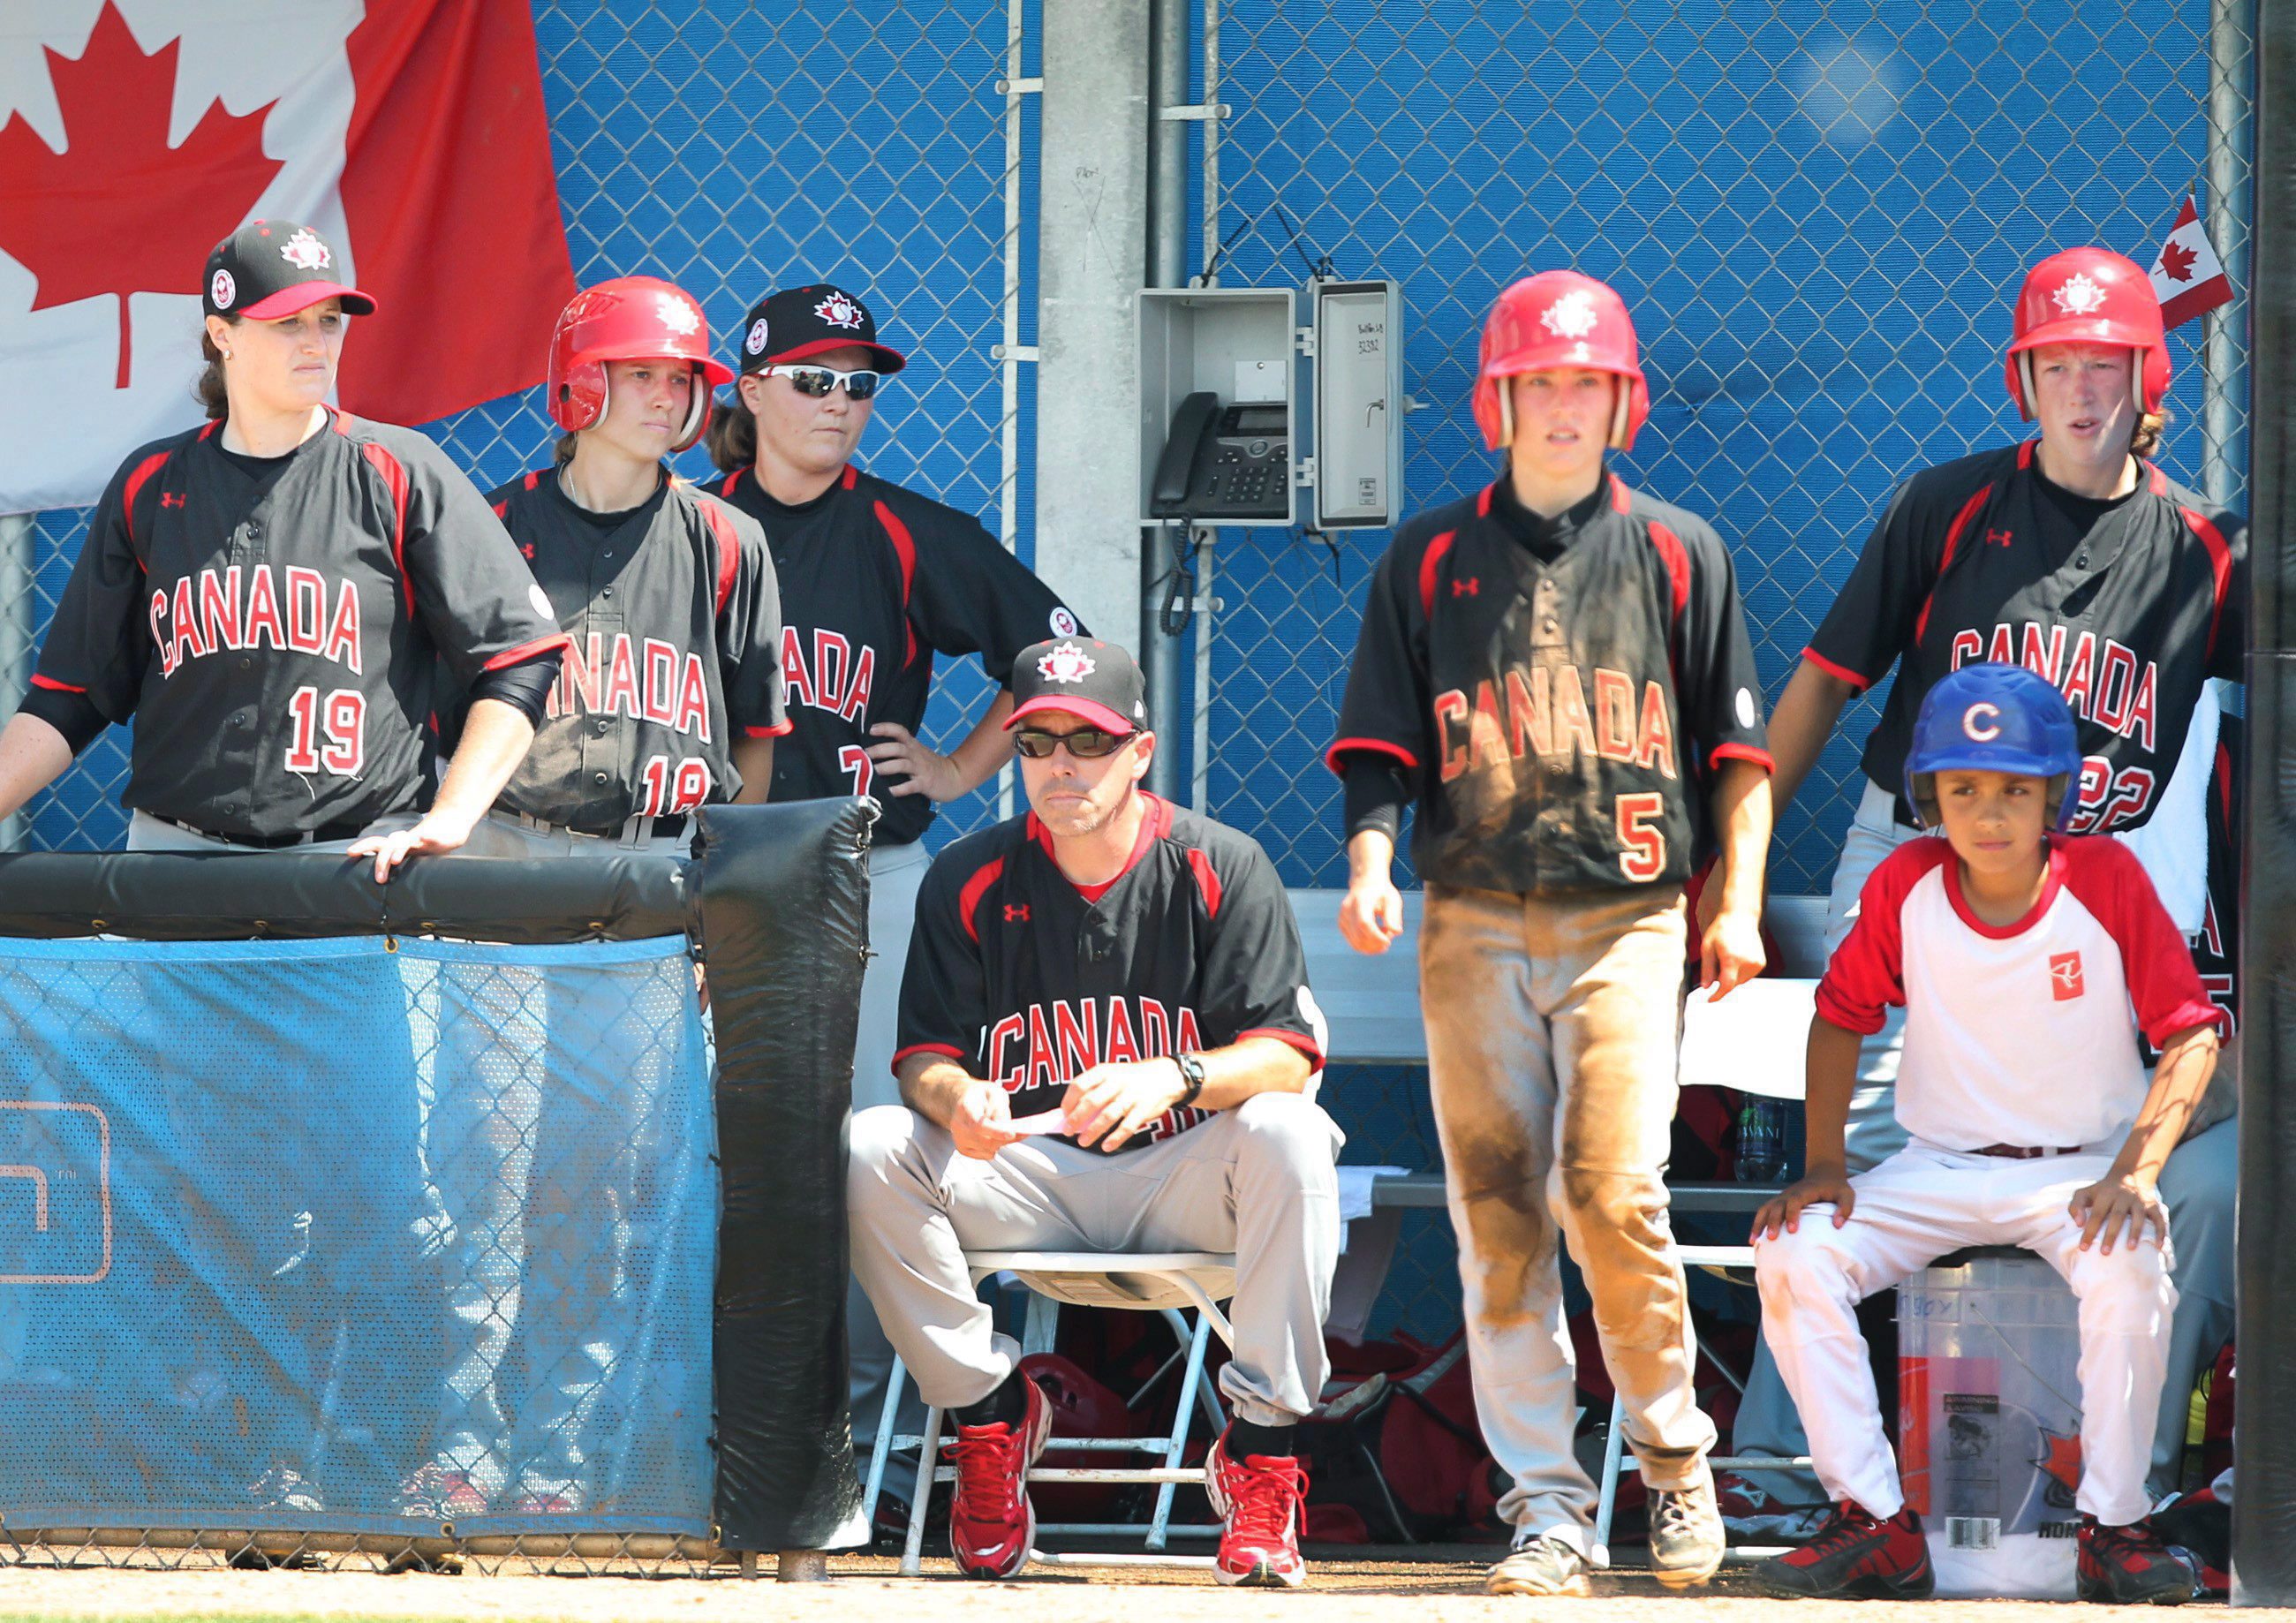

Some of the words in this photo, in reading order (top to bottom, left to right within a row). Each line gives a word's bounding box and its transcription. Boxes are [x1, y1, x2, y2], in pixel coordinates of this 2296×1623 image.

[150, 564, 362, 680] CANADA
[546, 631, 712, 744] NADA
[781, 626, 875, 734] ADA
[1434, 665, 1677, 783] CANADA
[1963, 702, 2000, 742] C
[284, 686, 367, 774] 19
[632, 755, 710, 818] 18
[2068, 756, 2156, 834] 22
[1615, 792, 1666, 883] 5
